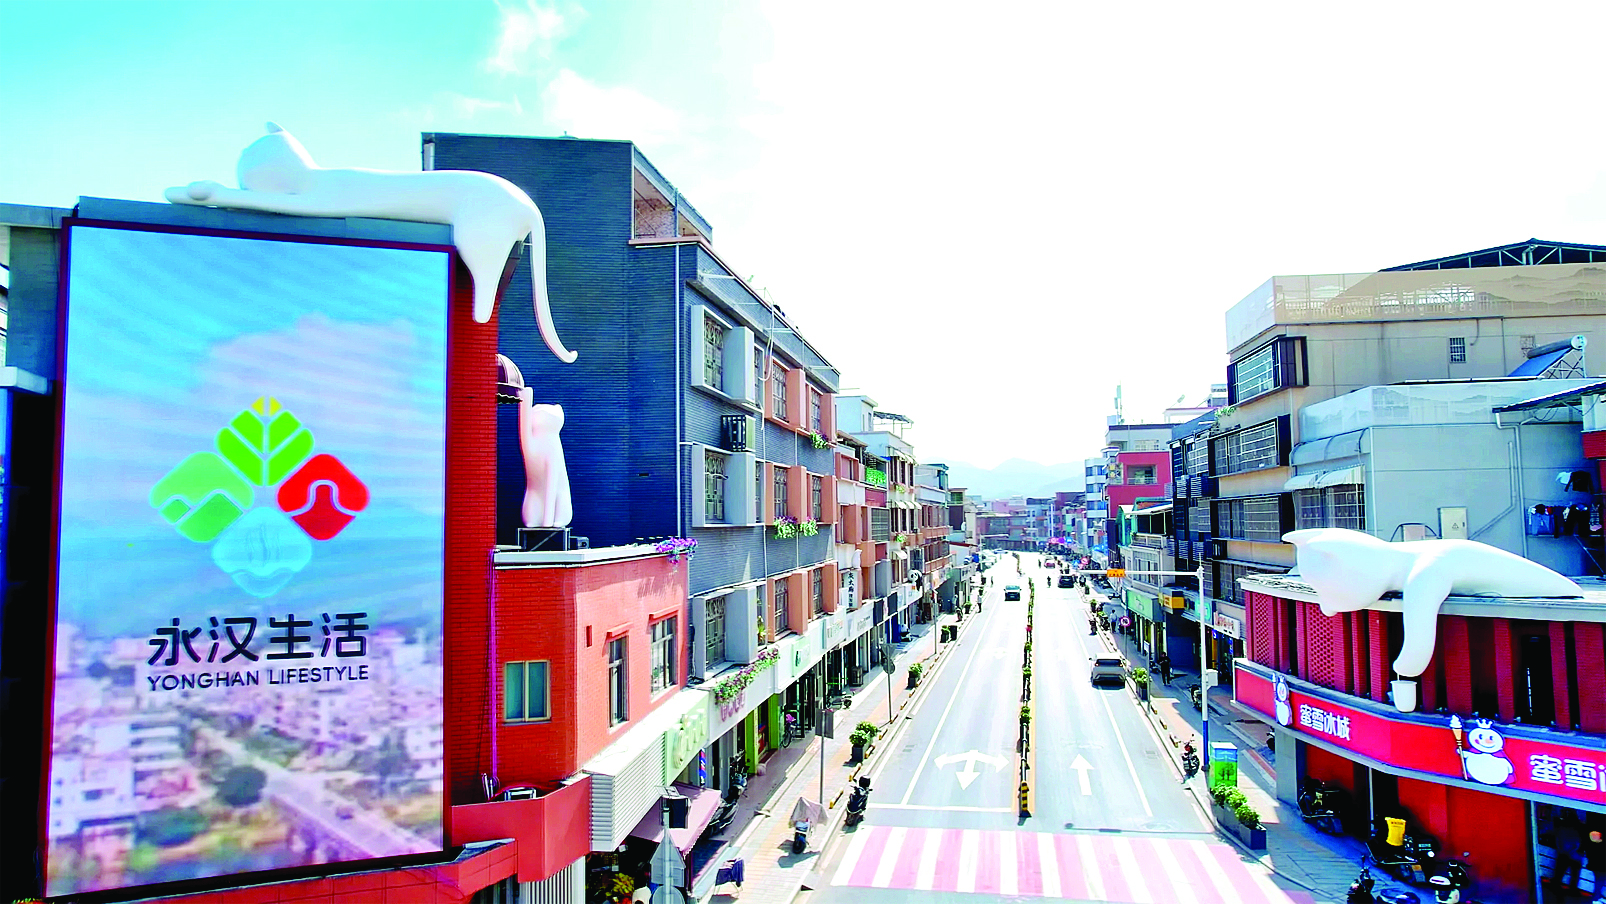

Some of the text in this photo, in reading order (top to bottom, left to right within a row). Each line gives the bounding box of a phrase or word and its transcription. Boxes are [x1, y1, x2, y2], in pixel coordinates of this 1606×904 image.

[148, 613, 369, 666] 永汉生活
[147, 665, 369, 691] YONGHAN LIFESTYLE
[1300, 704, 1351, 741] 蜜雪冰城
